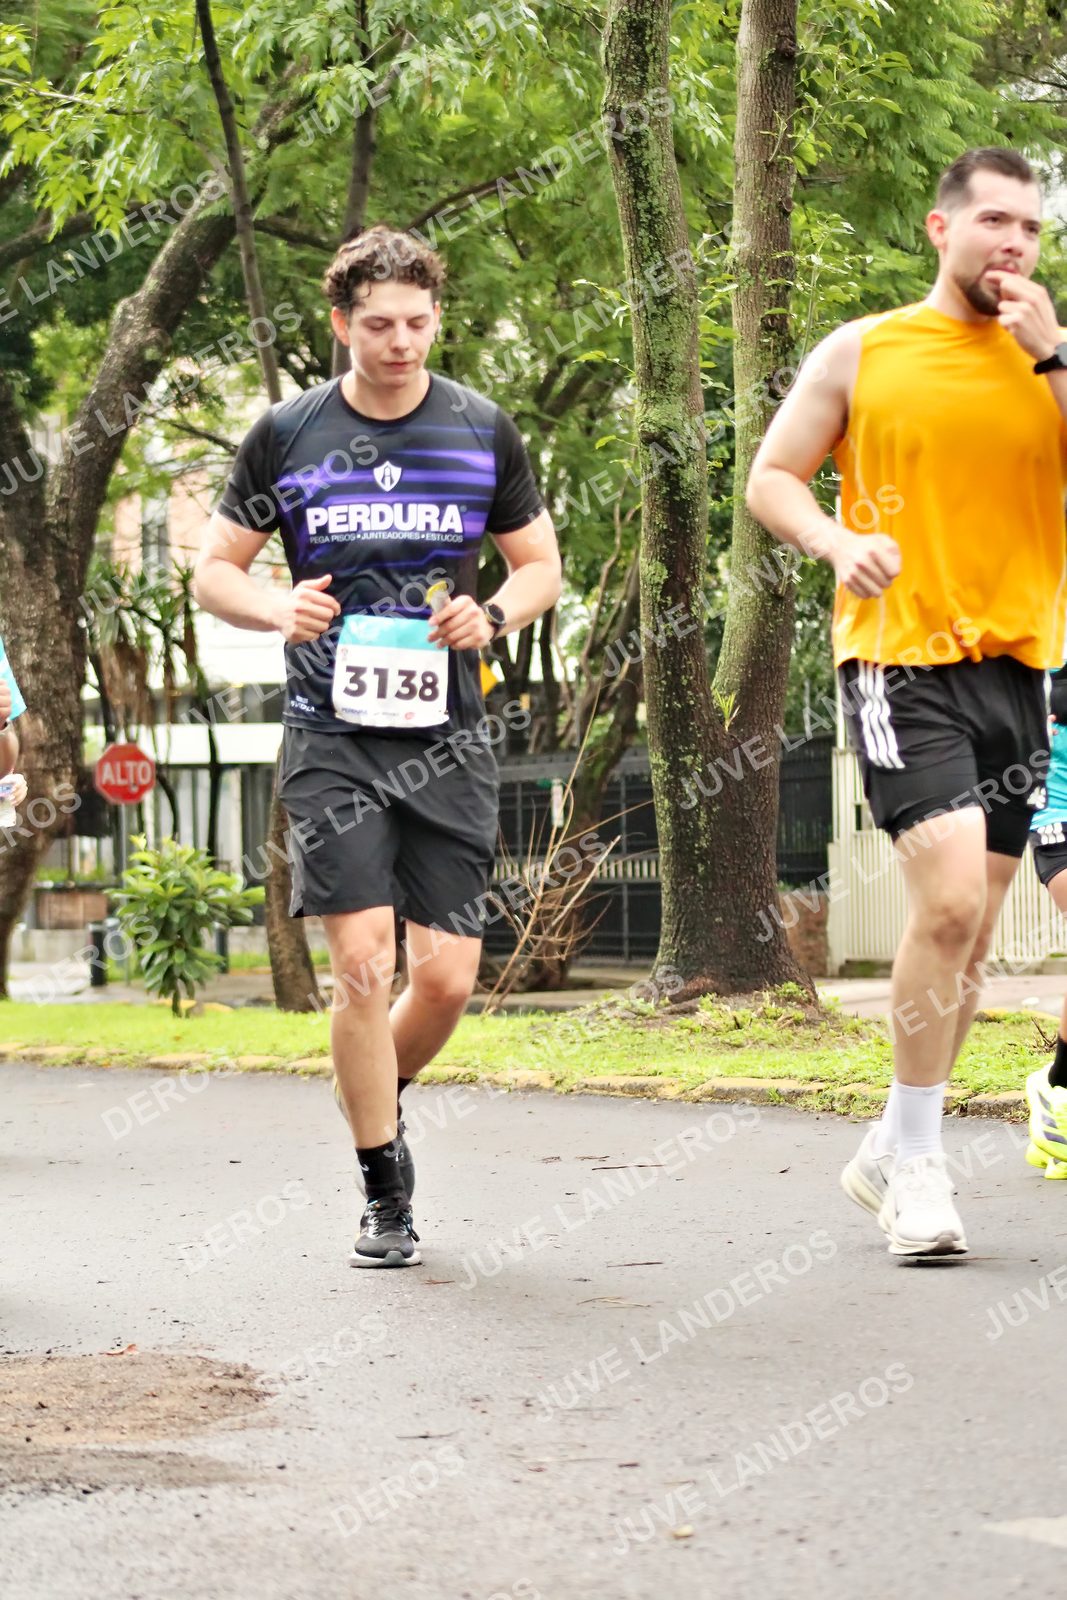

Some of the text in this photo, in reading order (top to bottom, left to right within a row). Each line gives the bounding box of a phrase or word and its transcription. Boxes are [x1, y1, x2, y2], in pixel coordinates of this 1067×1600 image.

[306, 502, 464, 535] PERDURA
[310, 531, 464, 544] PEGA PISOS JUNTEADORES ESTUCOS
[343, 665, 439, 701] 3138
[101, 760, 152, 786] ALTO
